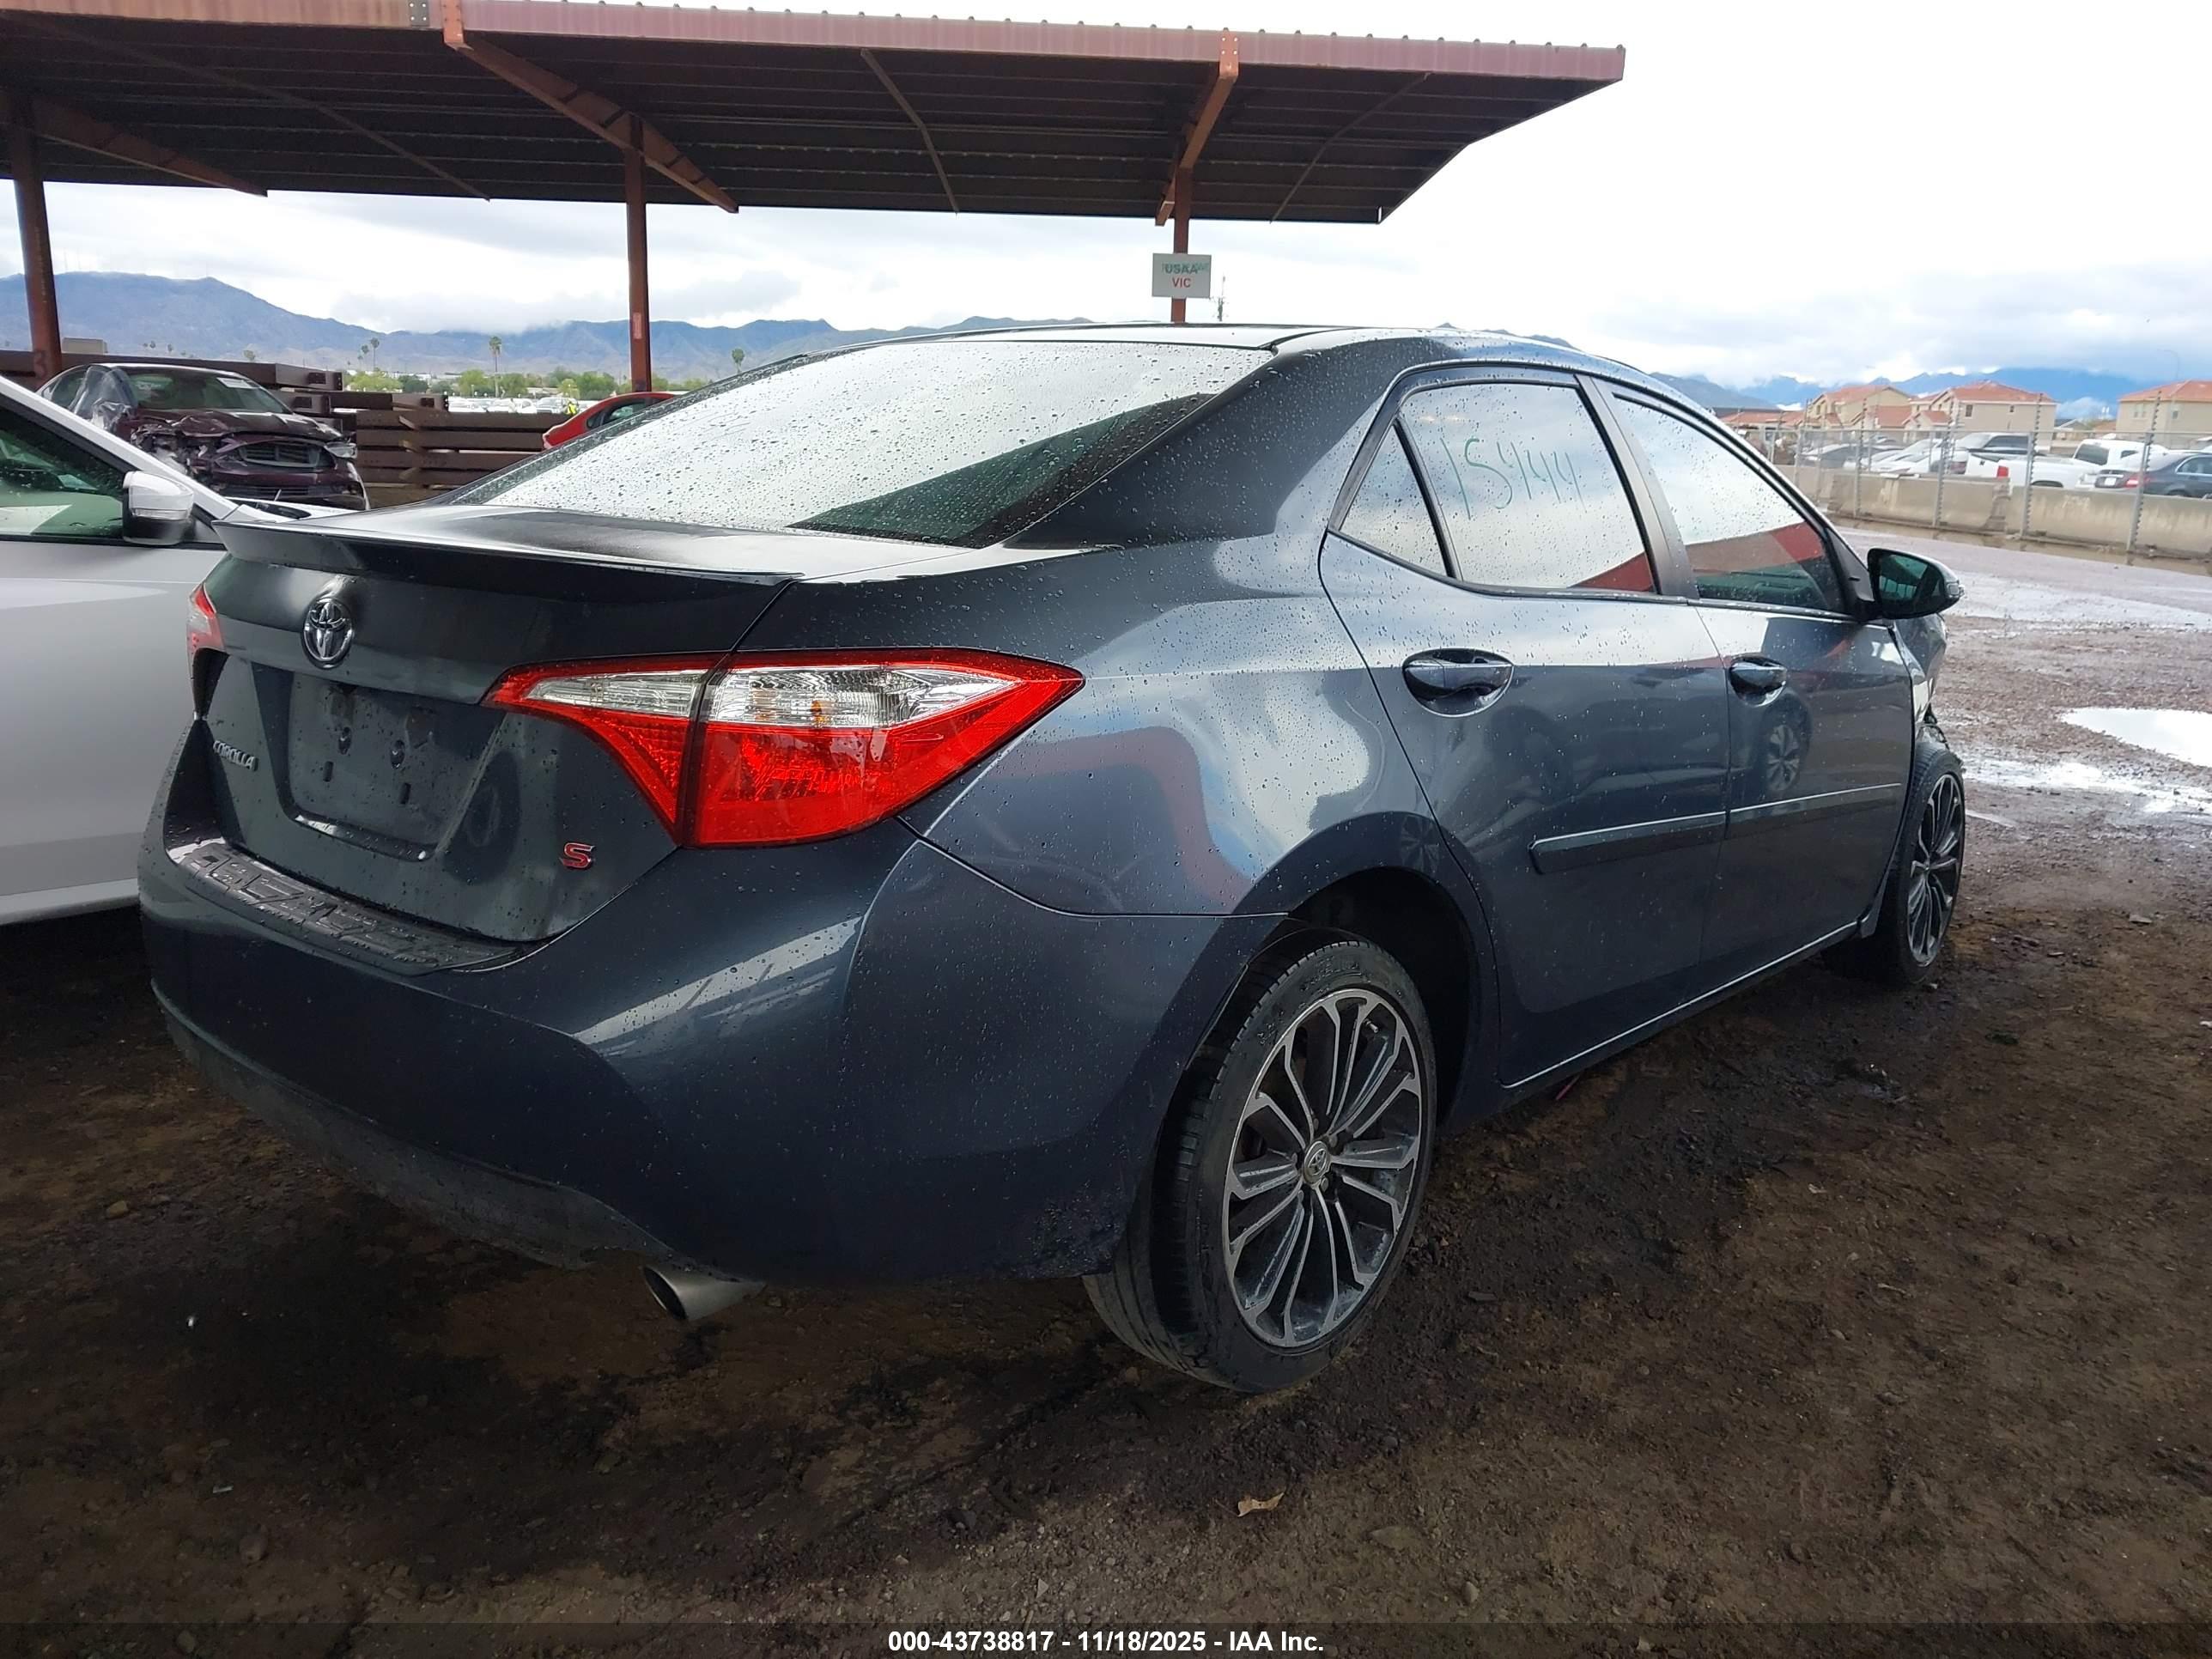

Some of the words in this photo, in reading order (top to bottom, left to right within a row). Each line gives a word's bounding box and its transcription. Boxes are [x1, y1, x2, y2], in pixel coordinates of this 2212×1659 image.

[1164, 263, 1199, 275] USAA
[1171, 276, 1192, 289] VIC
[213, 739, 258, 770] COROLLA
[559, 842, 596, 870] S
